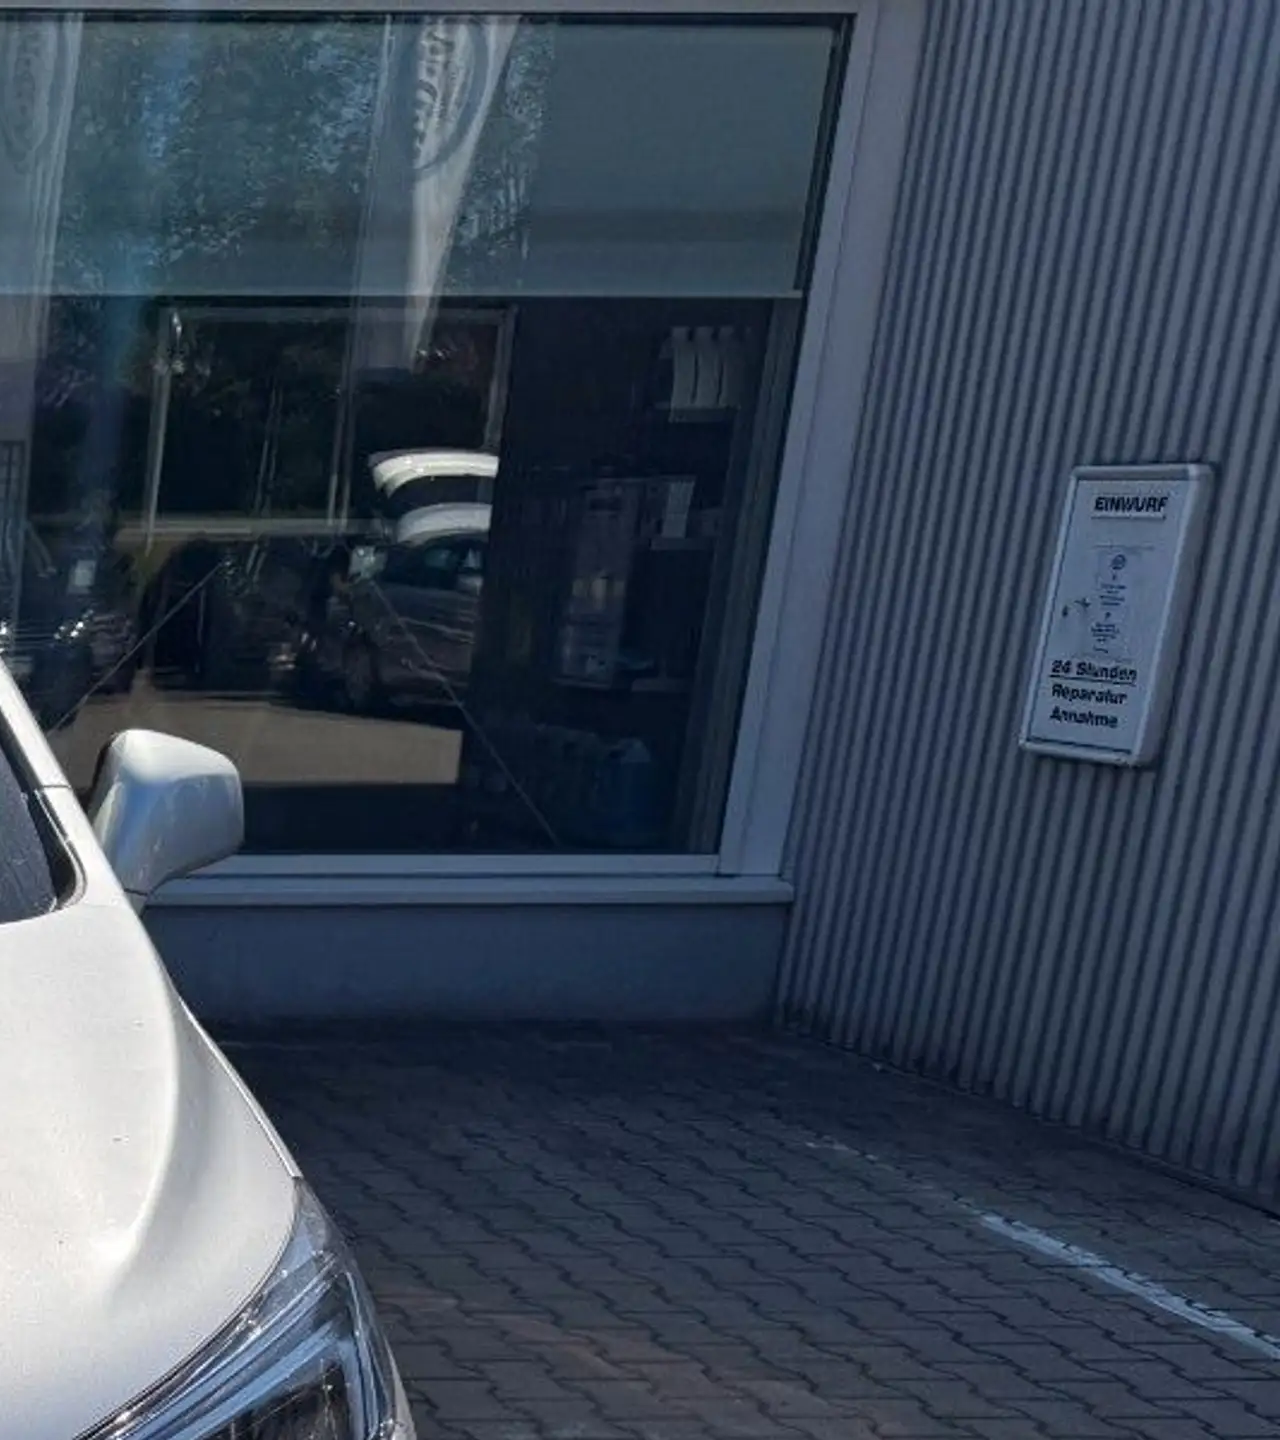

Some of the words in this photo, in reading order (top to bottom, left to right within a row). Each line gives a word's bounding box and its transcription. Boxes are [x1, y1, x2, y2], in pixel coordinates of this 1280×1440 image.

[1093, 496, 1169, 513] EINWURF
[1051, 659, 1072, 674] 24
[1076, 661, 1138, 681] Stunden
[1051, 683, 1128, 705] Reparatur
[1049, 705, 1119, 728] Annahme
